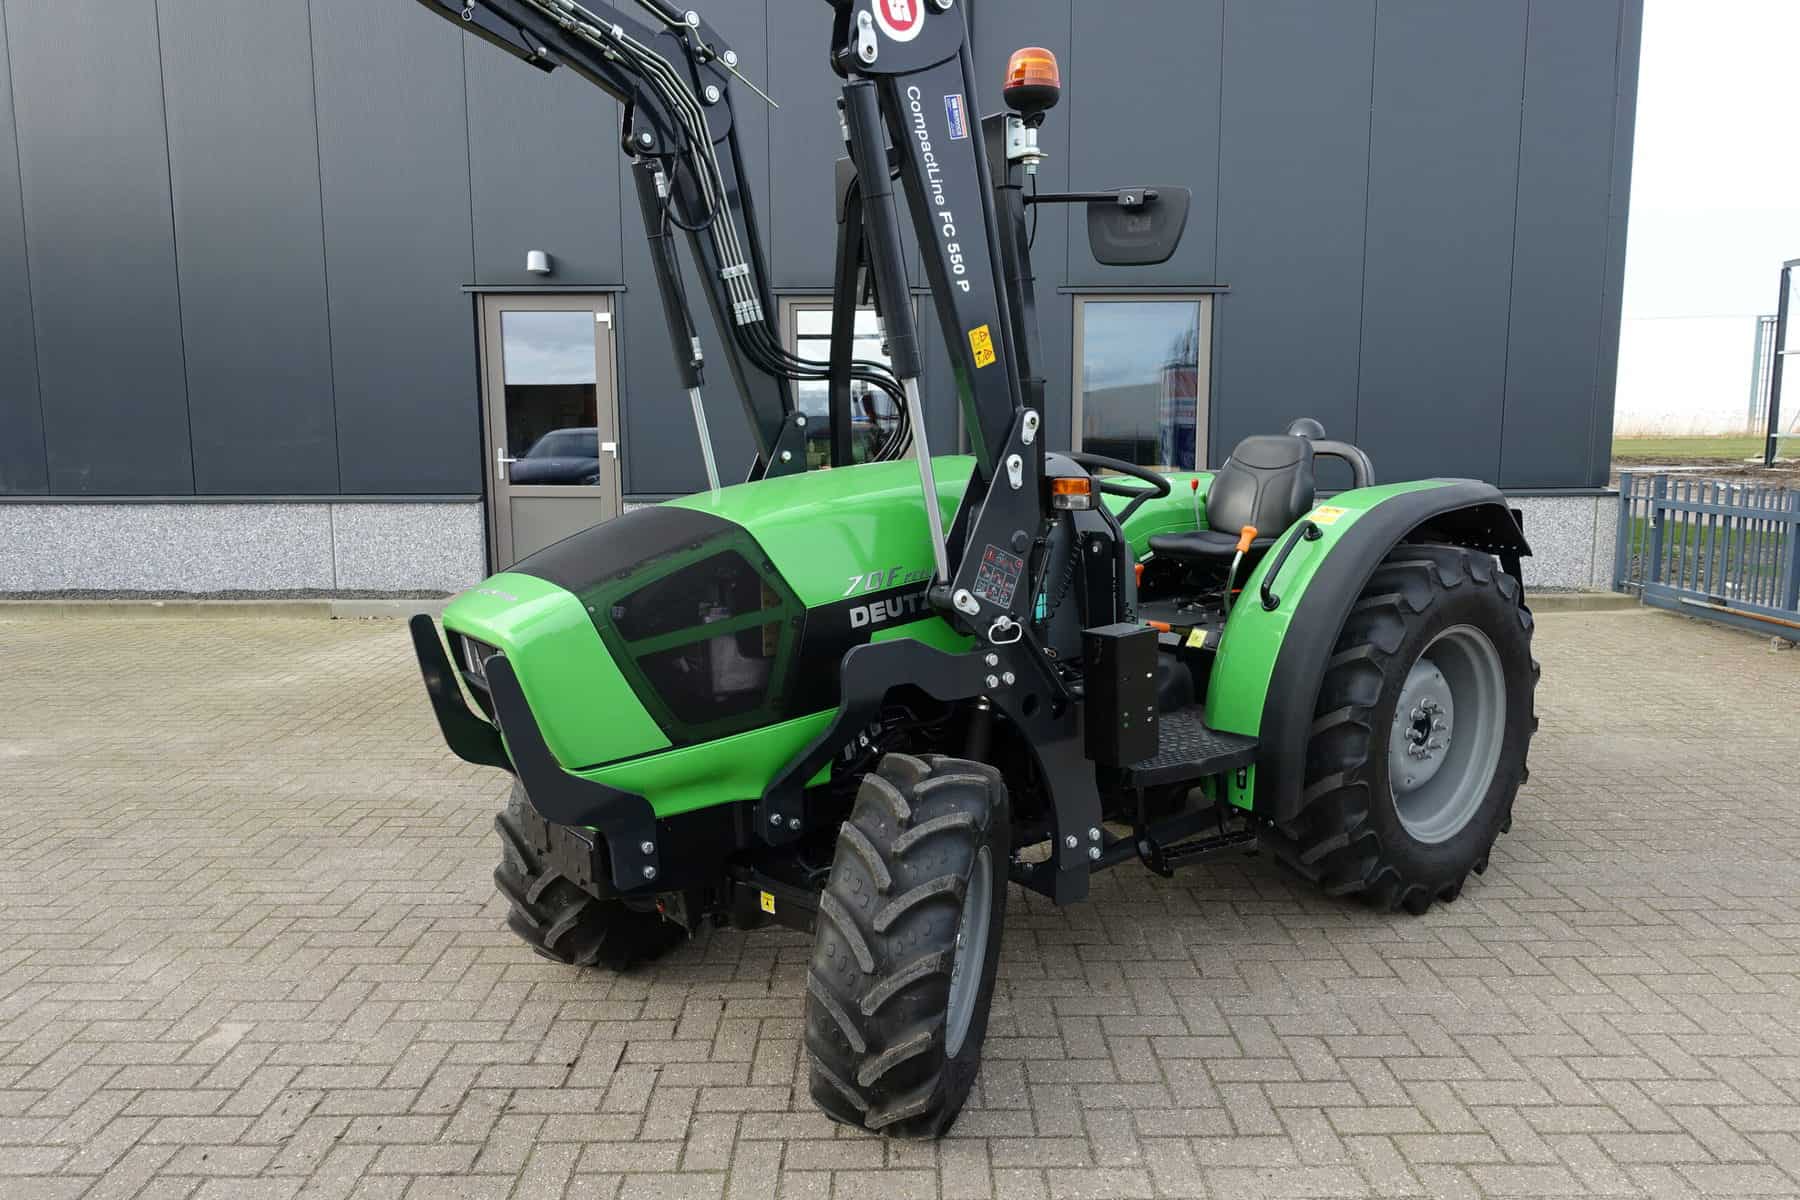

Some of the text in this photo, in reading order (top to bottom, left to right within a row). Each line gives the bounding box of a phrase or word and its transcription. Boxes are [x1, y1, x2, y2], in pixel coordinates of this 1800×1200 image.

[907, 86, 970, 292] CompactLine FC 550 P
